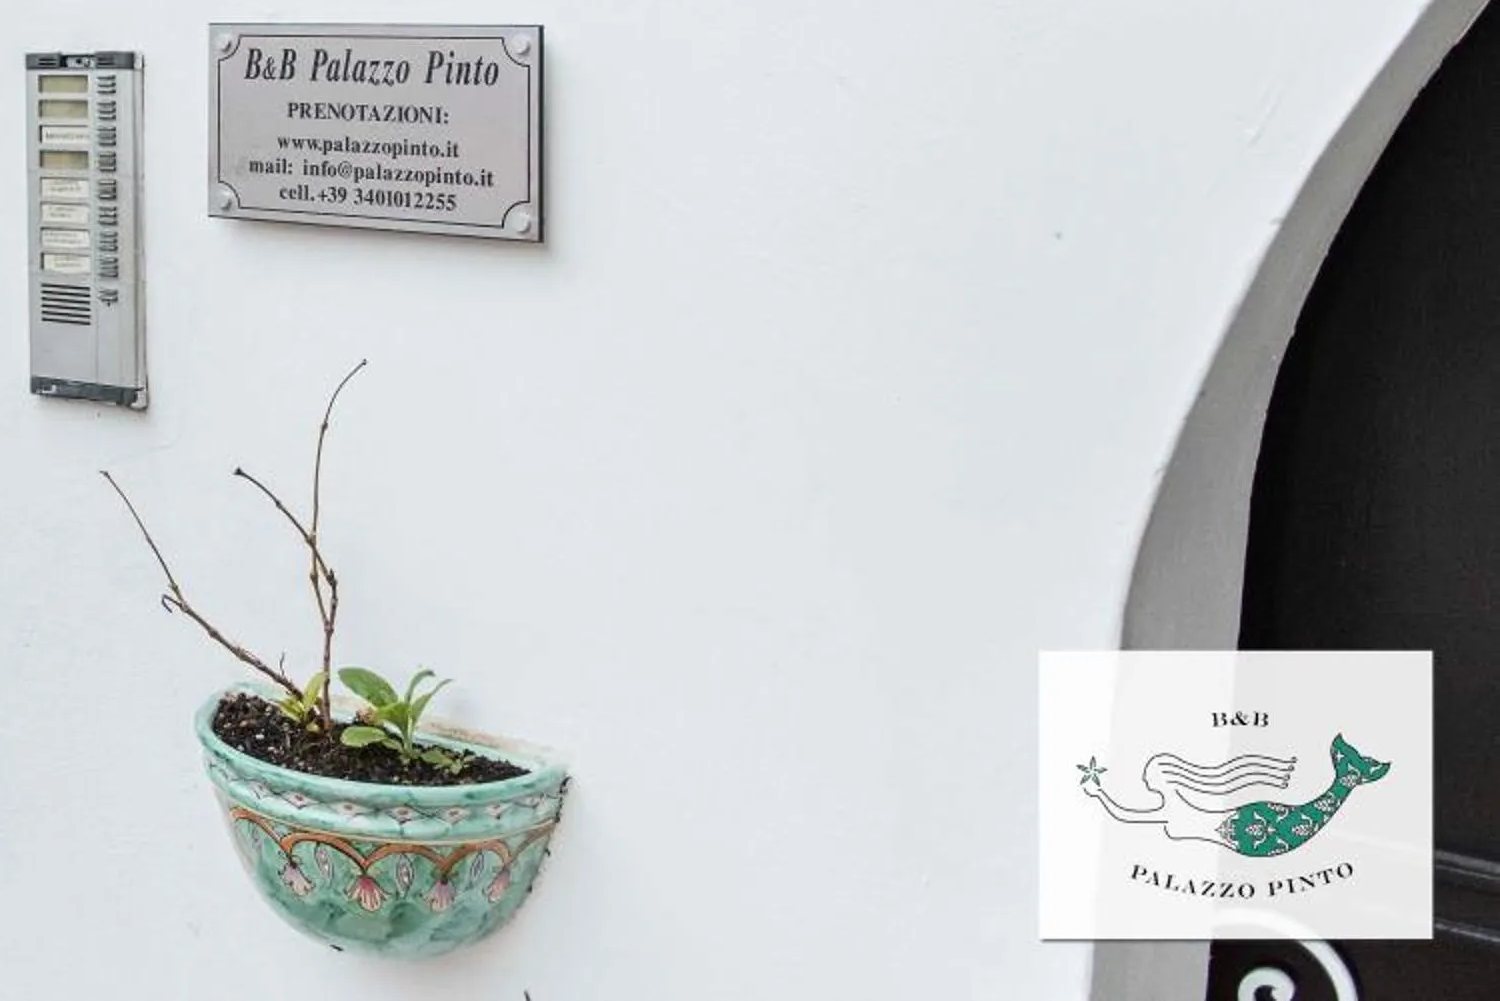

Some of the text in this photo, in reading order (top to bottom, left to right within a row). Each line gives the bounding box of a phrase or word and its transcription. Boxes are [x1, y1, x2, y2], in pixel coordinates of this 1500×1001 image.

[243, 47, 500, 87] B&B Palazzo Pinto
[287, 101, 450, 125] PRENOTAZIONI:
[276, 135, 461, 160] www.palazzopinto.it
[248, 158, 495, 188] mail: info@palazzopinto.it
